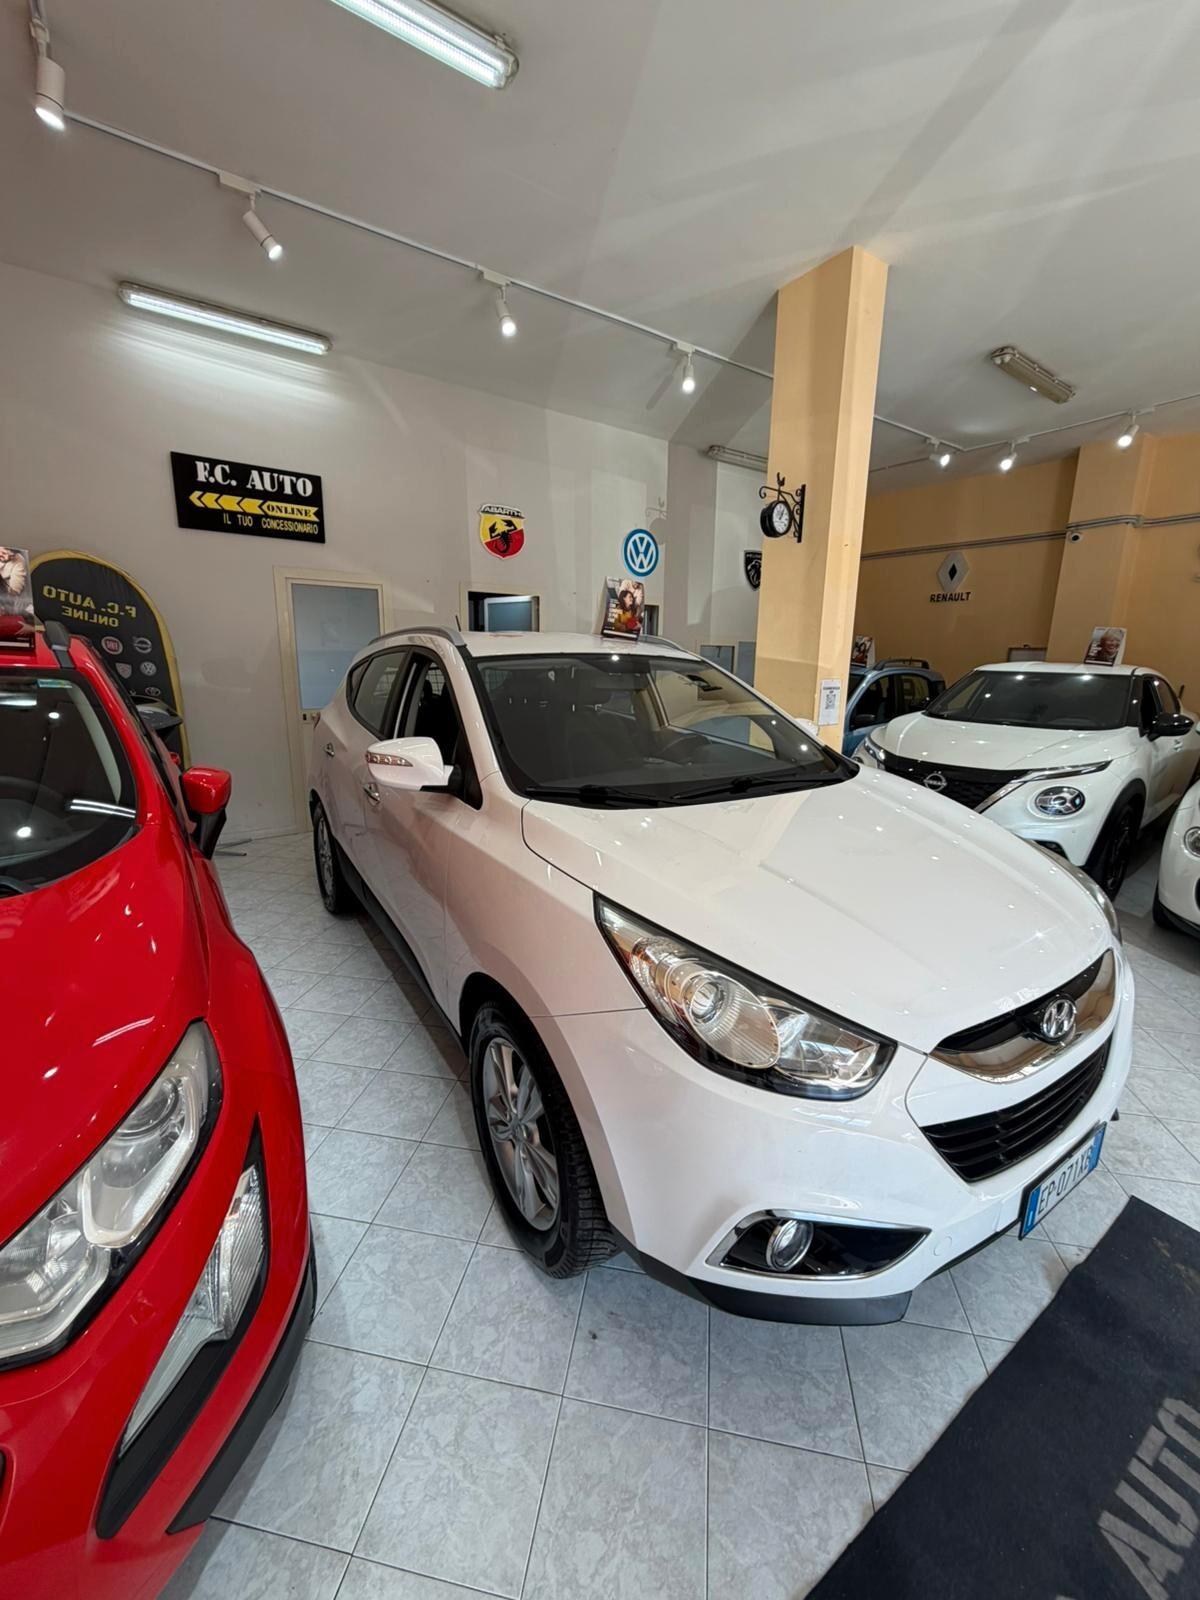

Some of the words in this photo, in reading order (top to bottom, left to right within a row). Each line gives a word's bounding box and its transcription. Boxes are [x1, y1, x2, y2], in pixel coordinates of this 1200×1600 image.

[195, 460, 238, 487] F.C.
[246, 469, 314, 498] AUTO
[266, 503, 312, 518] ONLINE
[484, 505, 522, 517] ABARTH
[223, 514, 231, 525] IL
[237, 514, 253, 527] TUO
[261, 518, 319, 535] CONCESSIONARIO
[929, 591, 972, 603] RENAULT
